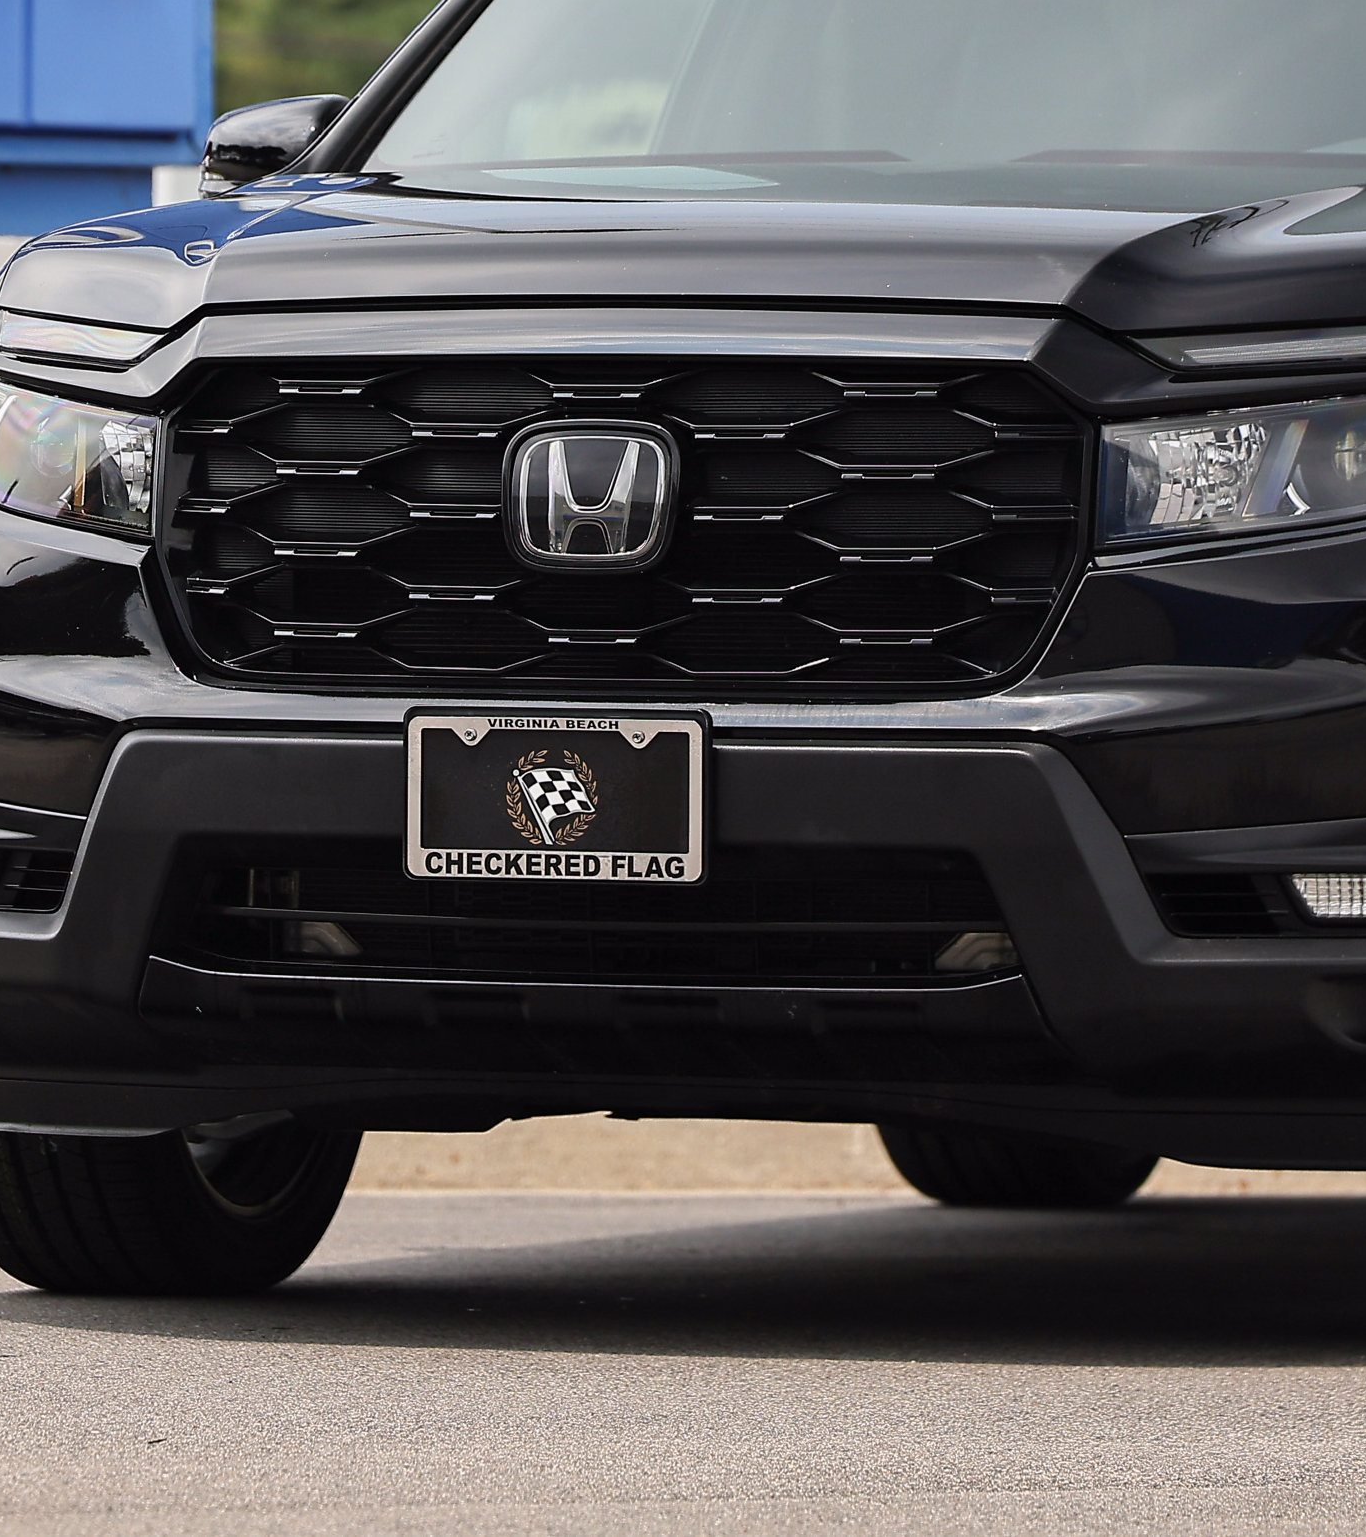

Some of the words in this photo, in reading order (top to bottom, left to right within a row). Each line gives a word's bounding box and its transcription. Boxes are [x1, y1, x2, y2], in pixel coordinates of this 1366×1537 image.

[487, 718, 560, 729] VIRGINIA
[566, 719, 619, 730] BEACH
[424, 851, 601, 877] CHECKERED
[611, 855, 685, 879] FLAG
